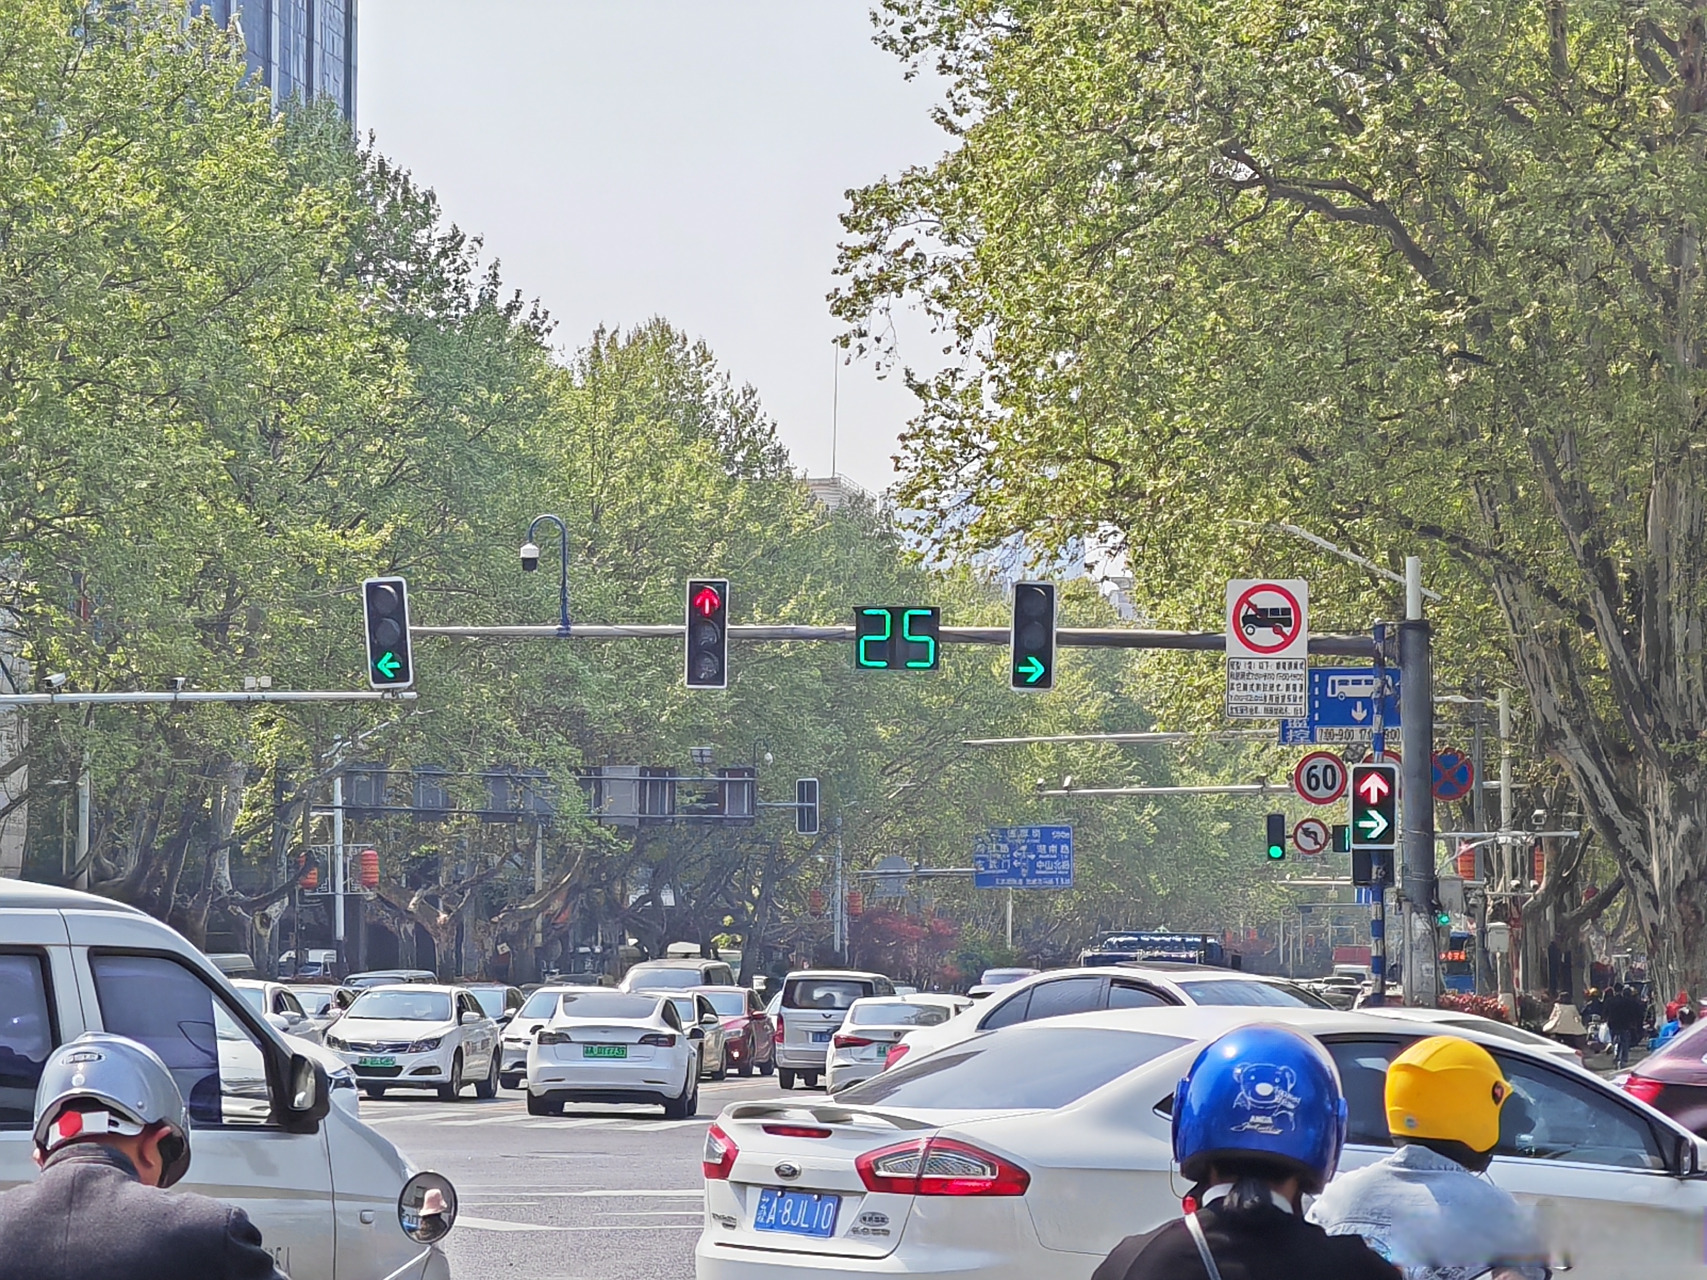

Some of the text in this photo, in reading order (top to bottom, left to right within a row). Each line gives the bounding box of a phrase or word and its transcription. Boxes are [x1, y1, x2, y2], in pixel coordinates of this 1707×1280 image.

[859, 608, 935, 668] 25
[1306, 764, 1337, 791] 60
[1036, 860, 1070, 870] 中山北路
